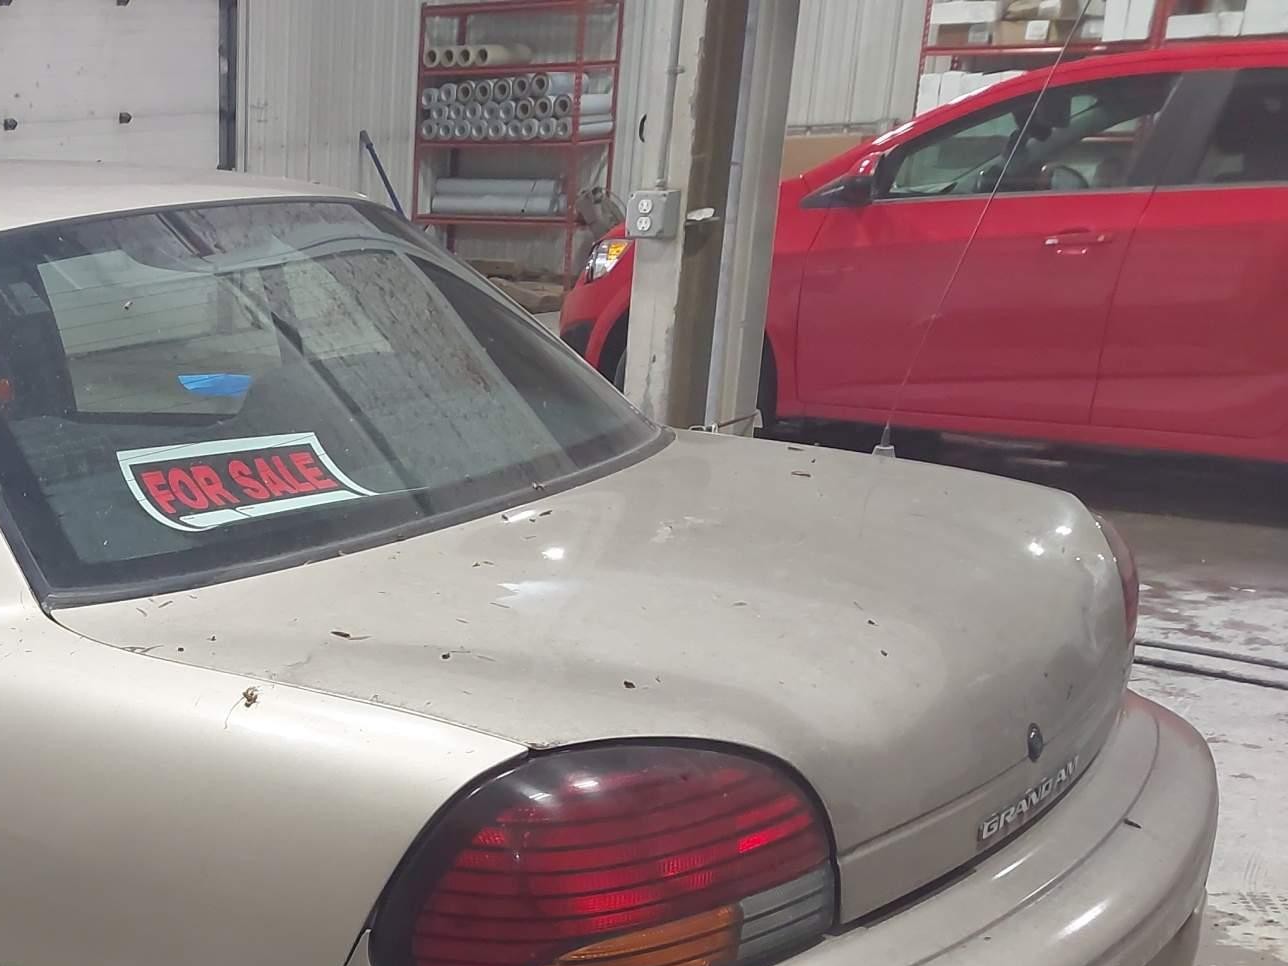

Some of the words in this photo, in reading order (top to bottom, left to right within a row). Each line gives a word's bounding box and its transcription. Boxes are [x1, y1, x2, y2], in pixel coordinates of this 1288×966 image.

[141, 465, 240, 514] FOR
[228, 452, 338, 499] SALE
[980, 776, 1054, 839] GRAND
[1054, 755, 1079, 788] AM
